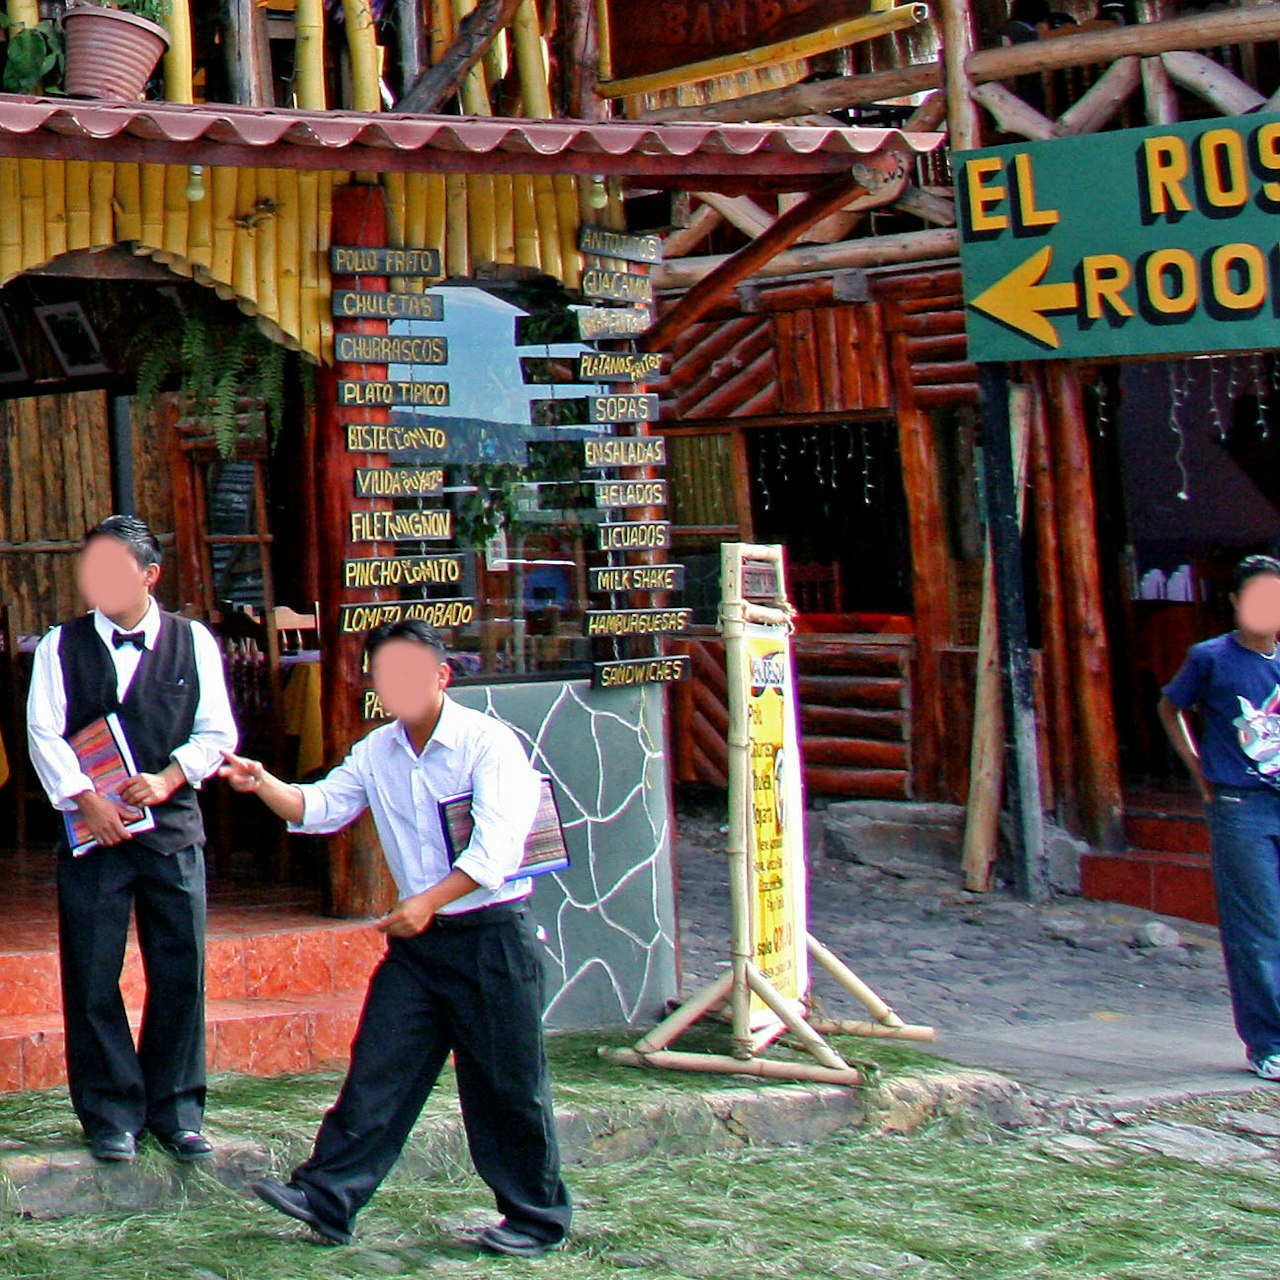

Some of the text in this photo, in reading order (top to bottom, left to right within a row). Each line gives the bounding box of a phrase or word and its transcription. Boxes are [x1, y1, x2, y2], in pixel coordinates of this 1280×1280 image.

[962, 153, 1061, 238] EL
[335, 250, 432, 272] POLLO FRITO
[1078, 243, 1280, 325] ROO
[343, 293, 434, 316] CHULETAS
[340, 336, 444, 363] CHURRASCOS
[580, 355, 633, 379] PLATANOS
[344, 383, 447, 405] PLATO TIPICO
[595, 397, 648, 421] SOPAS
[348, 425, 397, 451] BISTEC
[584, 440, 663, 466] ENSALADAS
[356, 469, 401, 495] VIUDA
[599, 483, 663, 506] HELADOS
[351, 510, 392, 542] FILET
[600, 524, 666, 551] LICUADOS
[345, 560, 402, 587] PINCHO
[403, 558, 459, 585] LOMITO
[597, 569, 675, 591] MILK SHAKE
[343, 605, 402, 632] LOMITO
[588, 611, 688, 636] HAMBURGUESAS
[601, 660, 684, 687] SANDWICHES
